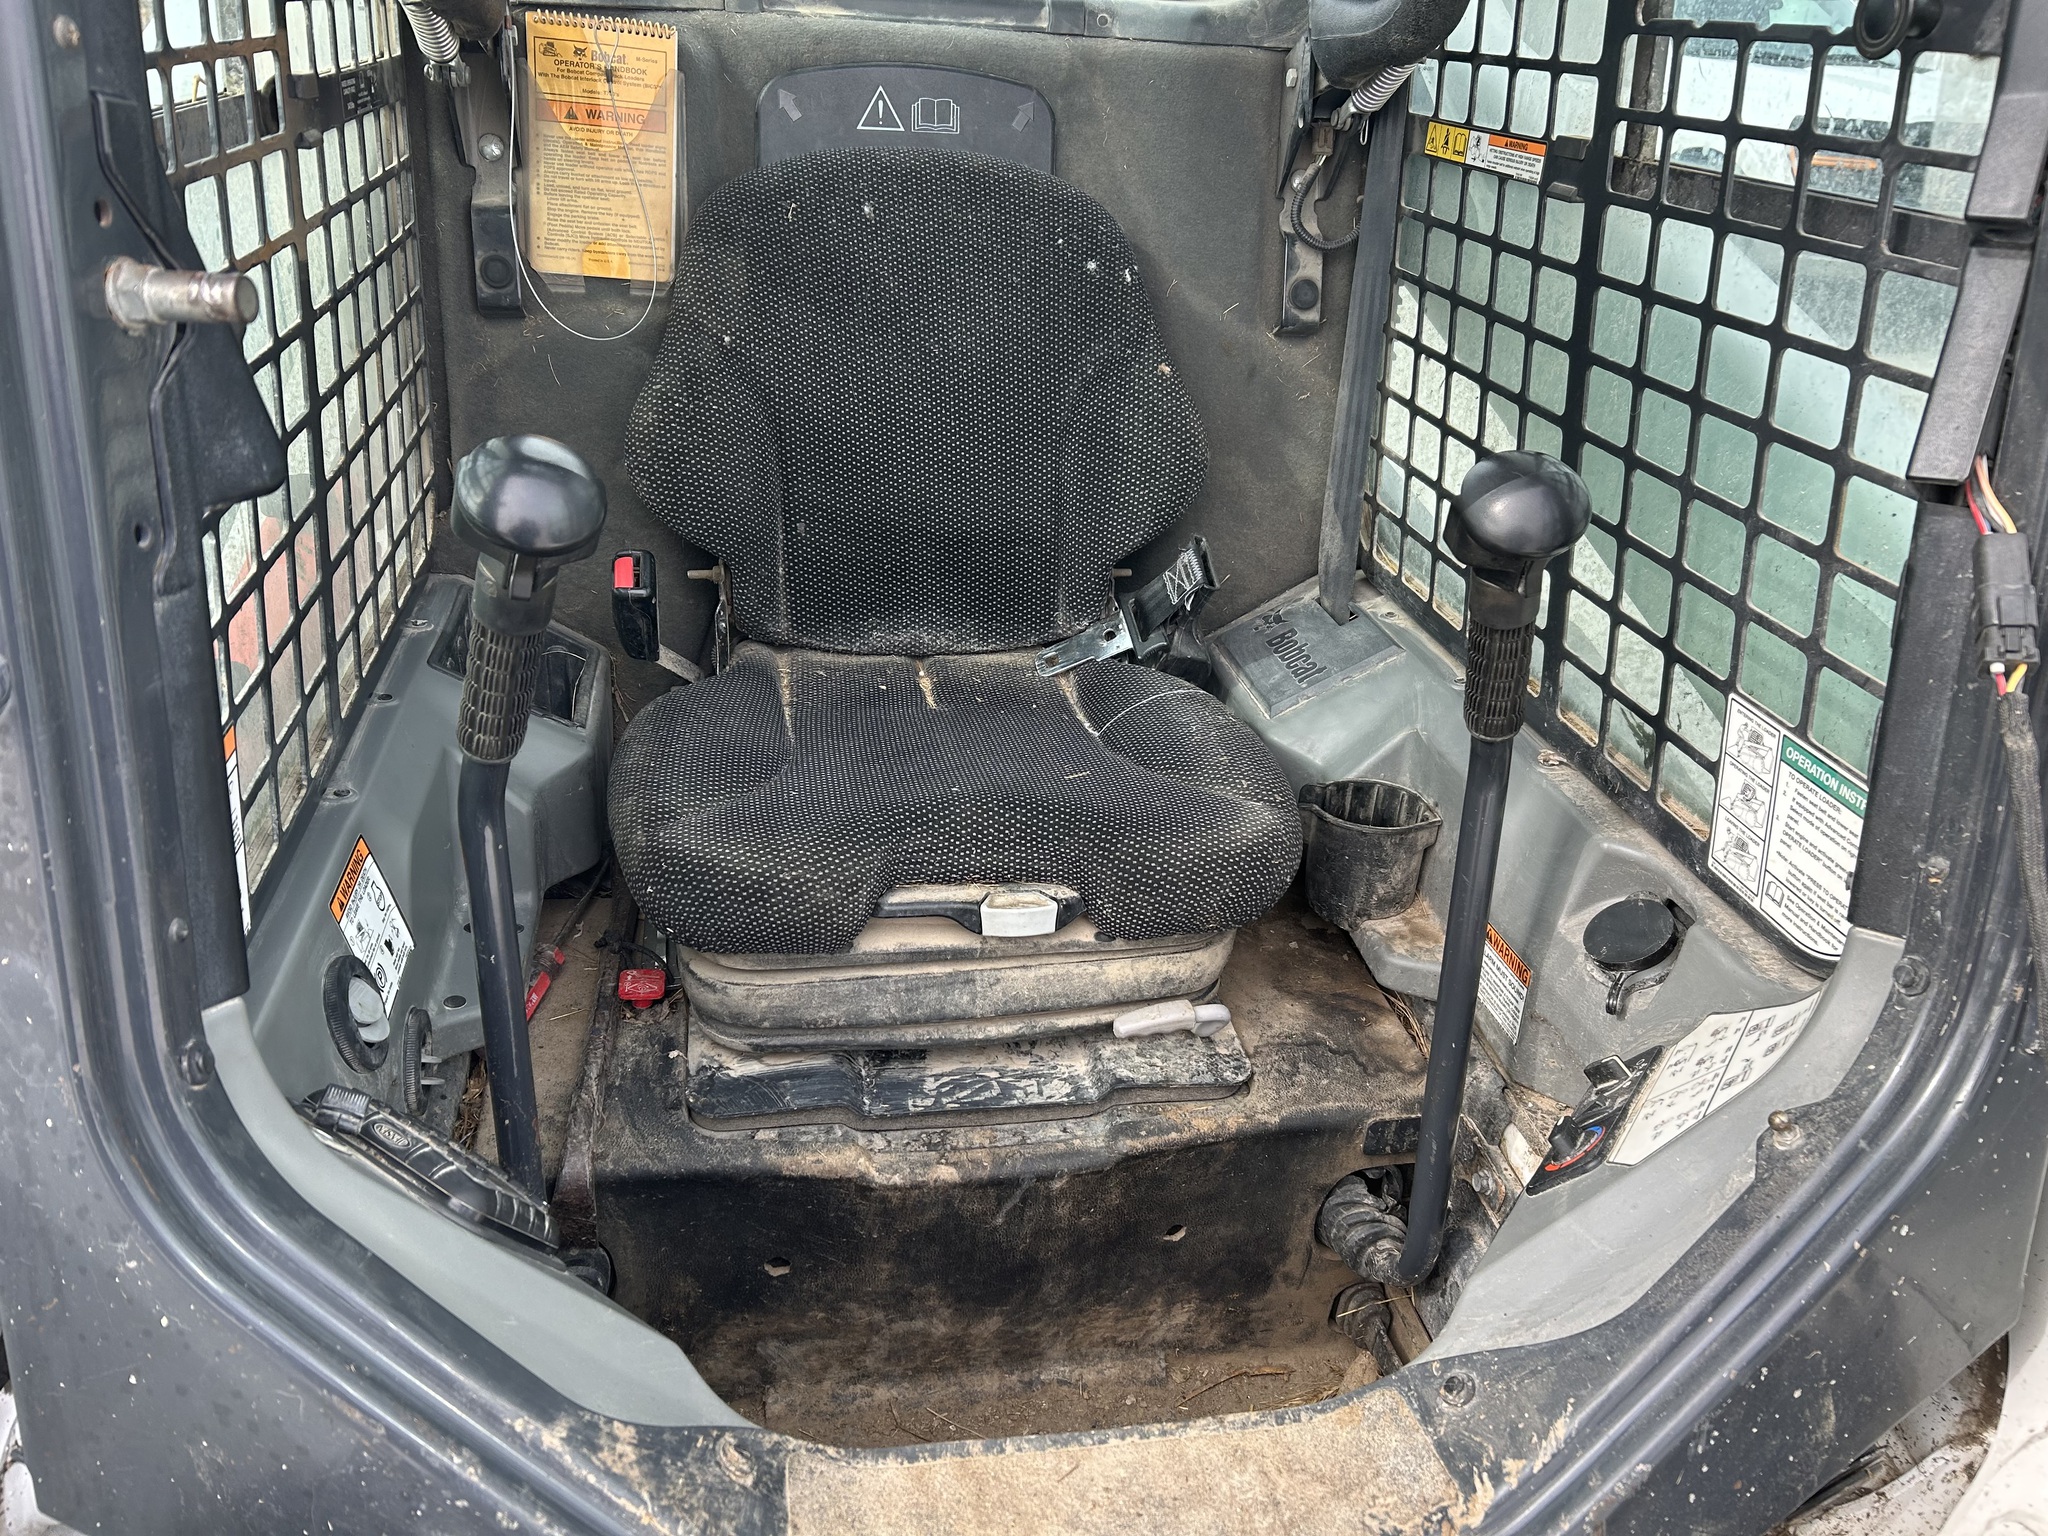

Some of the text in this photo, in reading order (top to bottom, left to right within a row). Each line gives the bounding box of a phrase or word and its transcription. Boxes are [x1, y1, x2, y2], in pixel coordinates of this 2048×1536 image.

[553, 58, 647, 76] OPERATOR'S NDBOOK
[591, 49, 658, 65] Bobcat M-Series
[561, 73, 579, 81] Bobcat
[579, 76, 601, 84] Interlock
[624, 74, 644, 82] Loaders
[585, 108, 645, 125] WARNING
[585, 127, 604, 135] INJURY
[1509, 140, 1528, 151] WARNING
[1265, 627, 1328, 685] Bobcat
[1737, 708, 1754, 723] ENTERING
[1762, 726, 1776, 738] LOADER
[1730, 761, 1748, 777] OPERATING
[1755, 781, 1769, 793] LOADER
[1786, 747, 1839, 791] OPERATION
[1796, 777, 1819, 797] OPERATE
[1819, 794, 1841, 814] LOADER:
[340, 849, 364, 900] WARNING
[1492, 933, 1528, 984] WARNING
